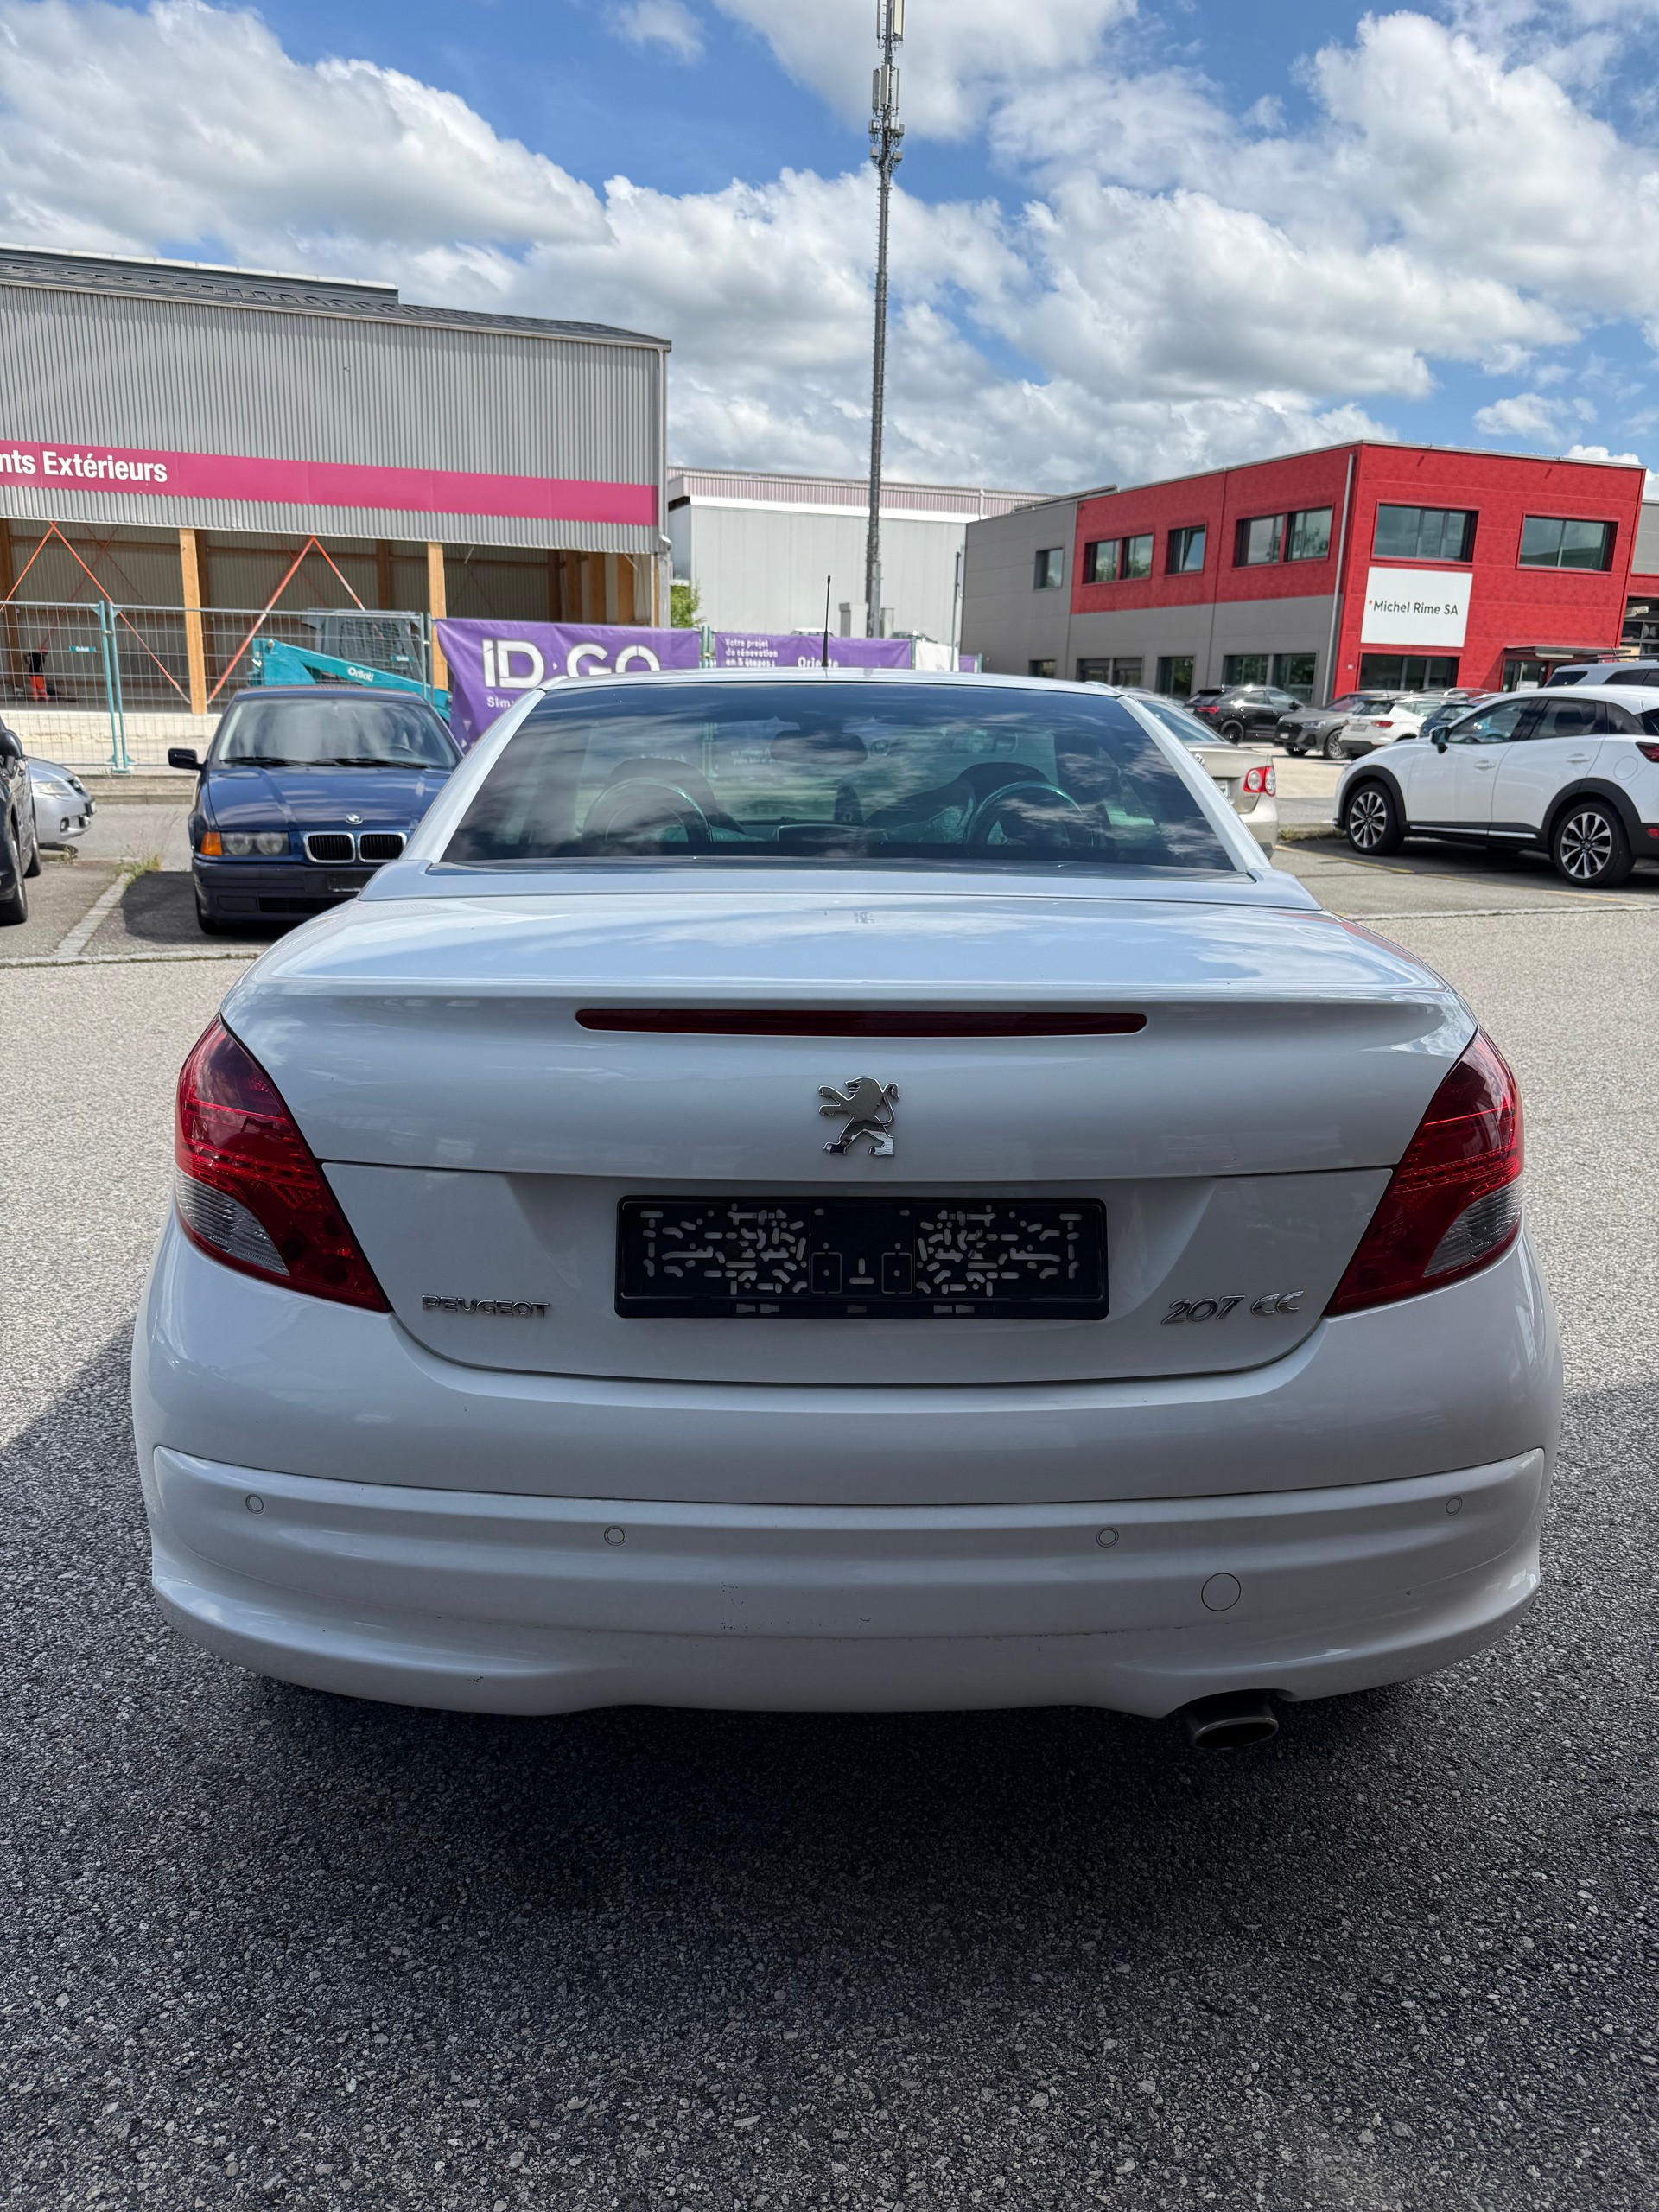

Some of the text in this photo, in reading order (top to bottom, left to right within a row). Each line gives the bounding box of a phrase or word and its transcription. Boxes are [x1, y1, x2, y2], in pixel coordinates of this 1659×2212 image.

[42, 450, 168, 482] Extérieurs
[1373, 600, 1459, 615] Michel Rime SA
[724, 638, 768, 649] Votre projet
[726, 647, 778, 658] de rénovation
[486, 696, 515, 708] Sim
[422, 1294, 550, 1319] PEUGEOT
[1160, 1290, 1304, 1325] 207 CC
